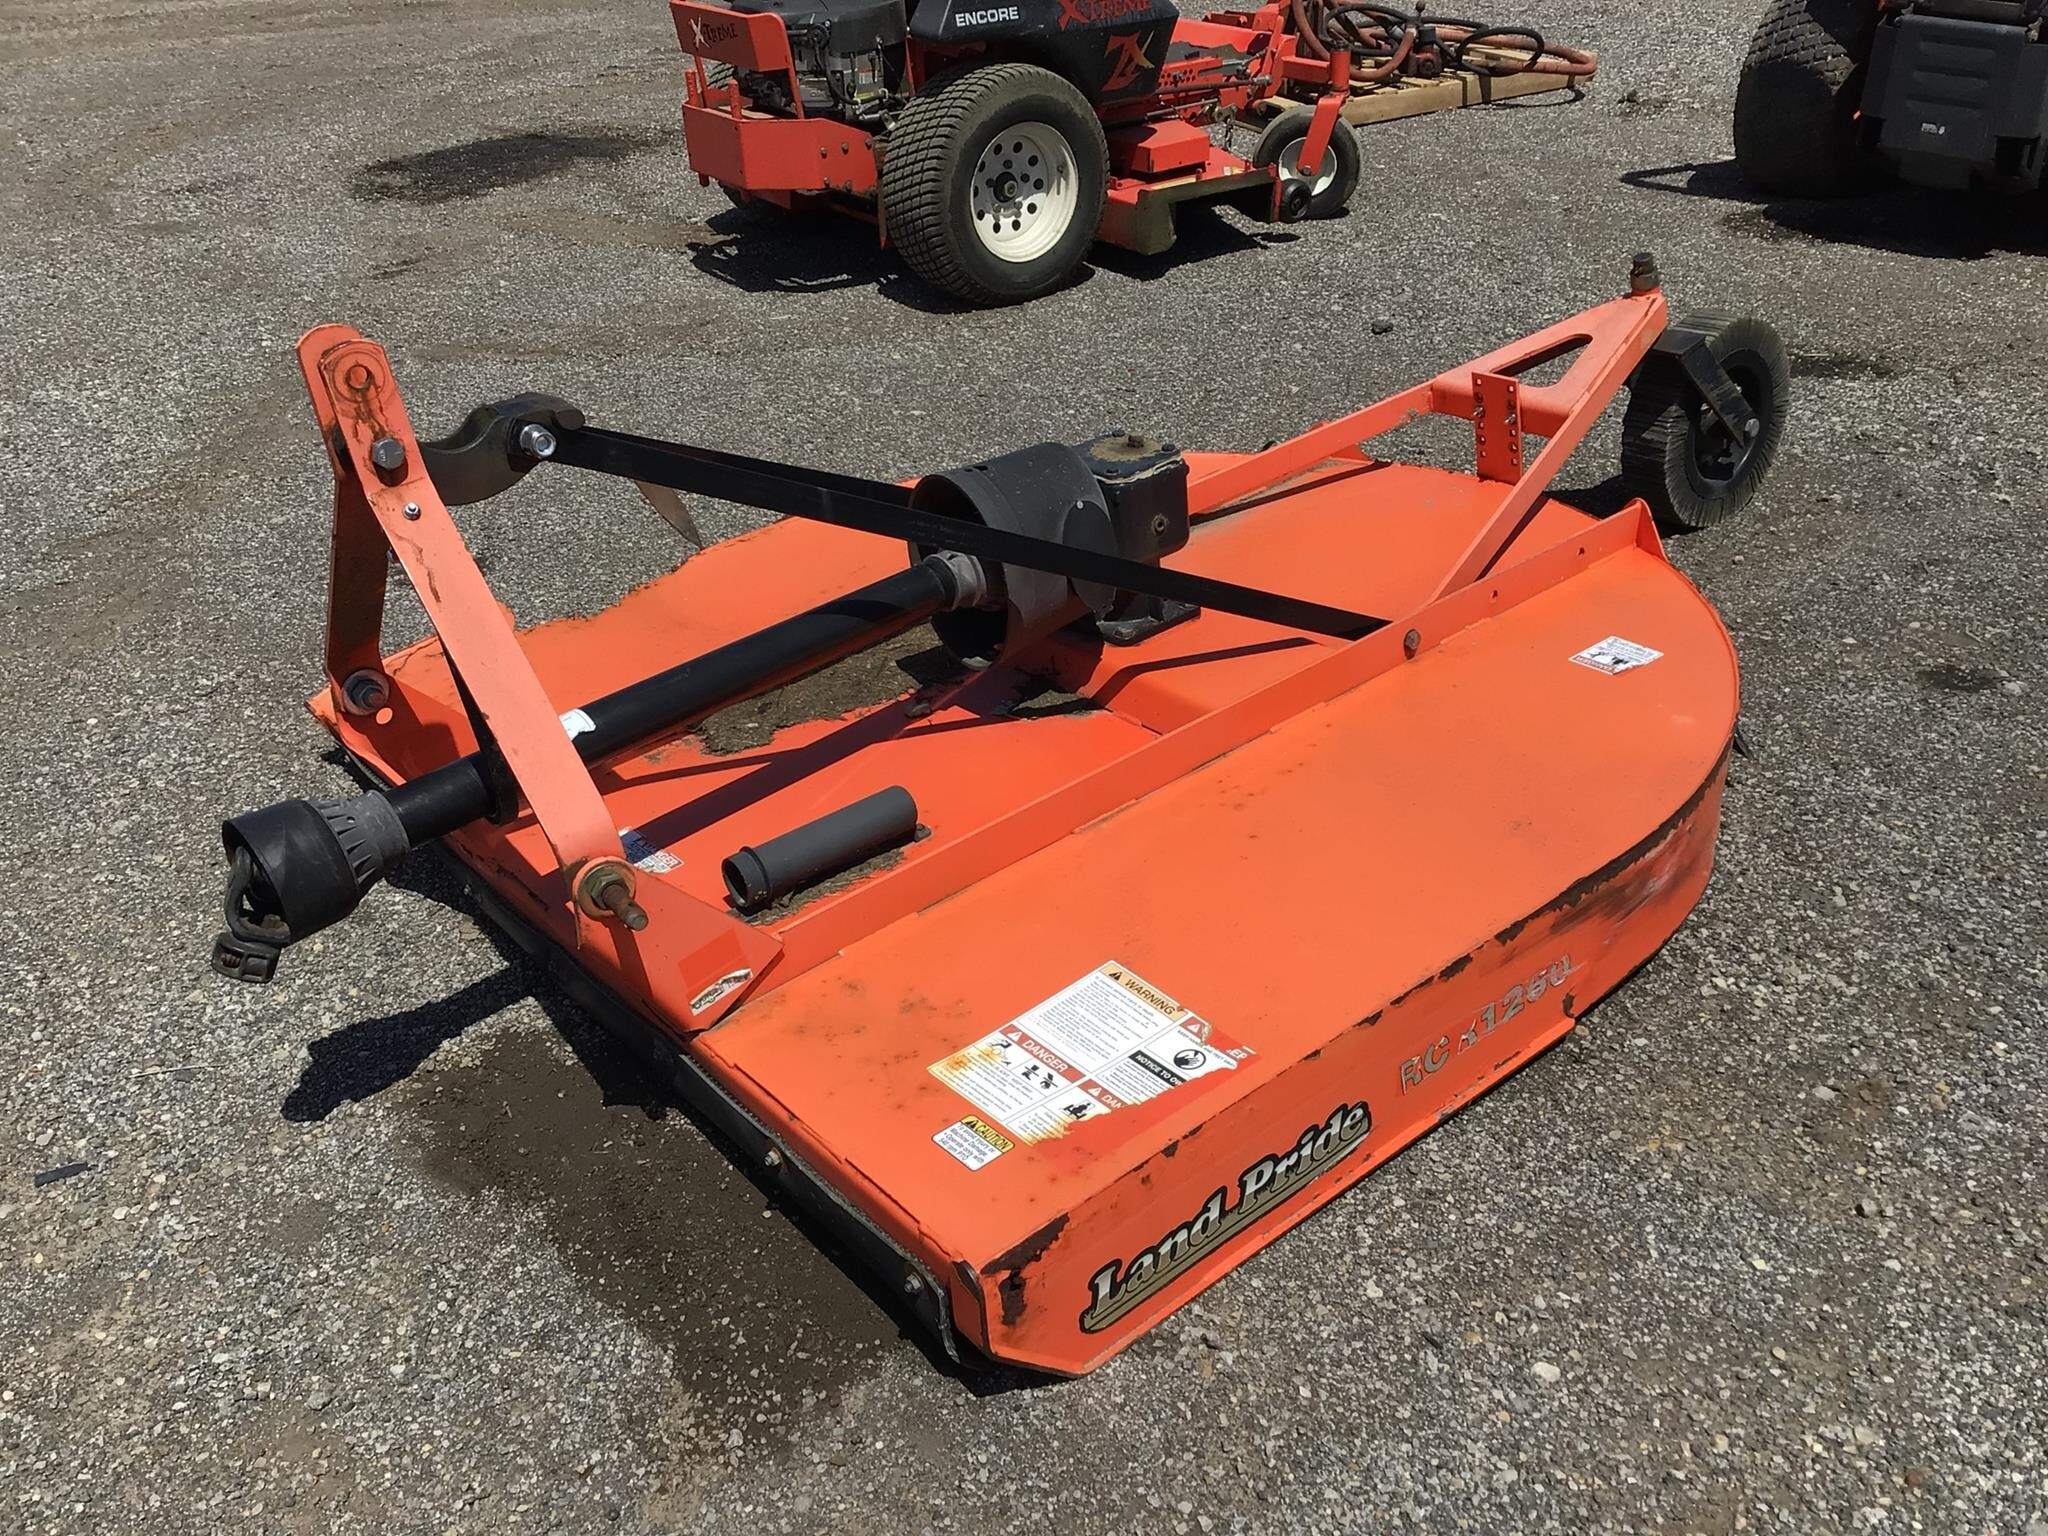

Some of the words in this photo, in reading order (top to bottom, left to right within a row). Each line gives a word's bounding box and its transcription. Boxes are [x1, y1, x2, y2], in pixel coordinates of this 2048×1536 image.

[688, 16, 738, 48] XTREME
[955, 6, 1020, 27] ENCORE
[1124, 978, 1176, 1015] WARNING
[1021, 1039, 1069, 1073] DANGER
[1134, 1053, 1162, 1074] NOTICE
[1160, 1069, 1172, 1080] TO
[975, 1124, 1011, 1150] CAUTION
[1081, 1191, 1224, 1319] Land
[1237, 1104, 1370, 1215] Pride
